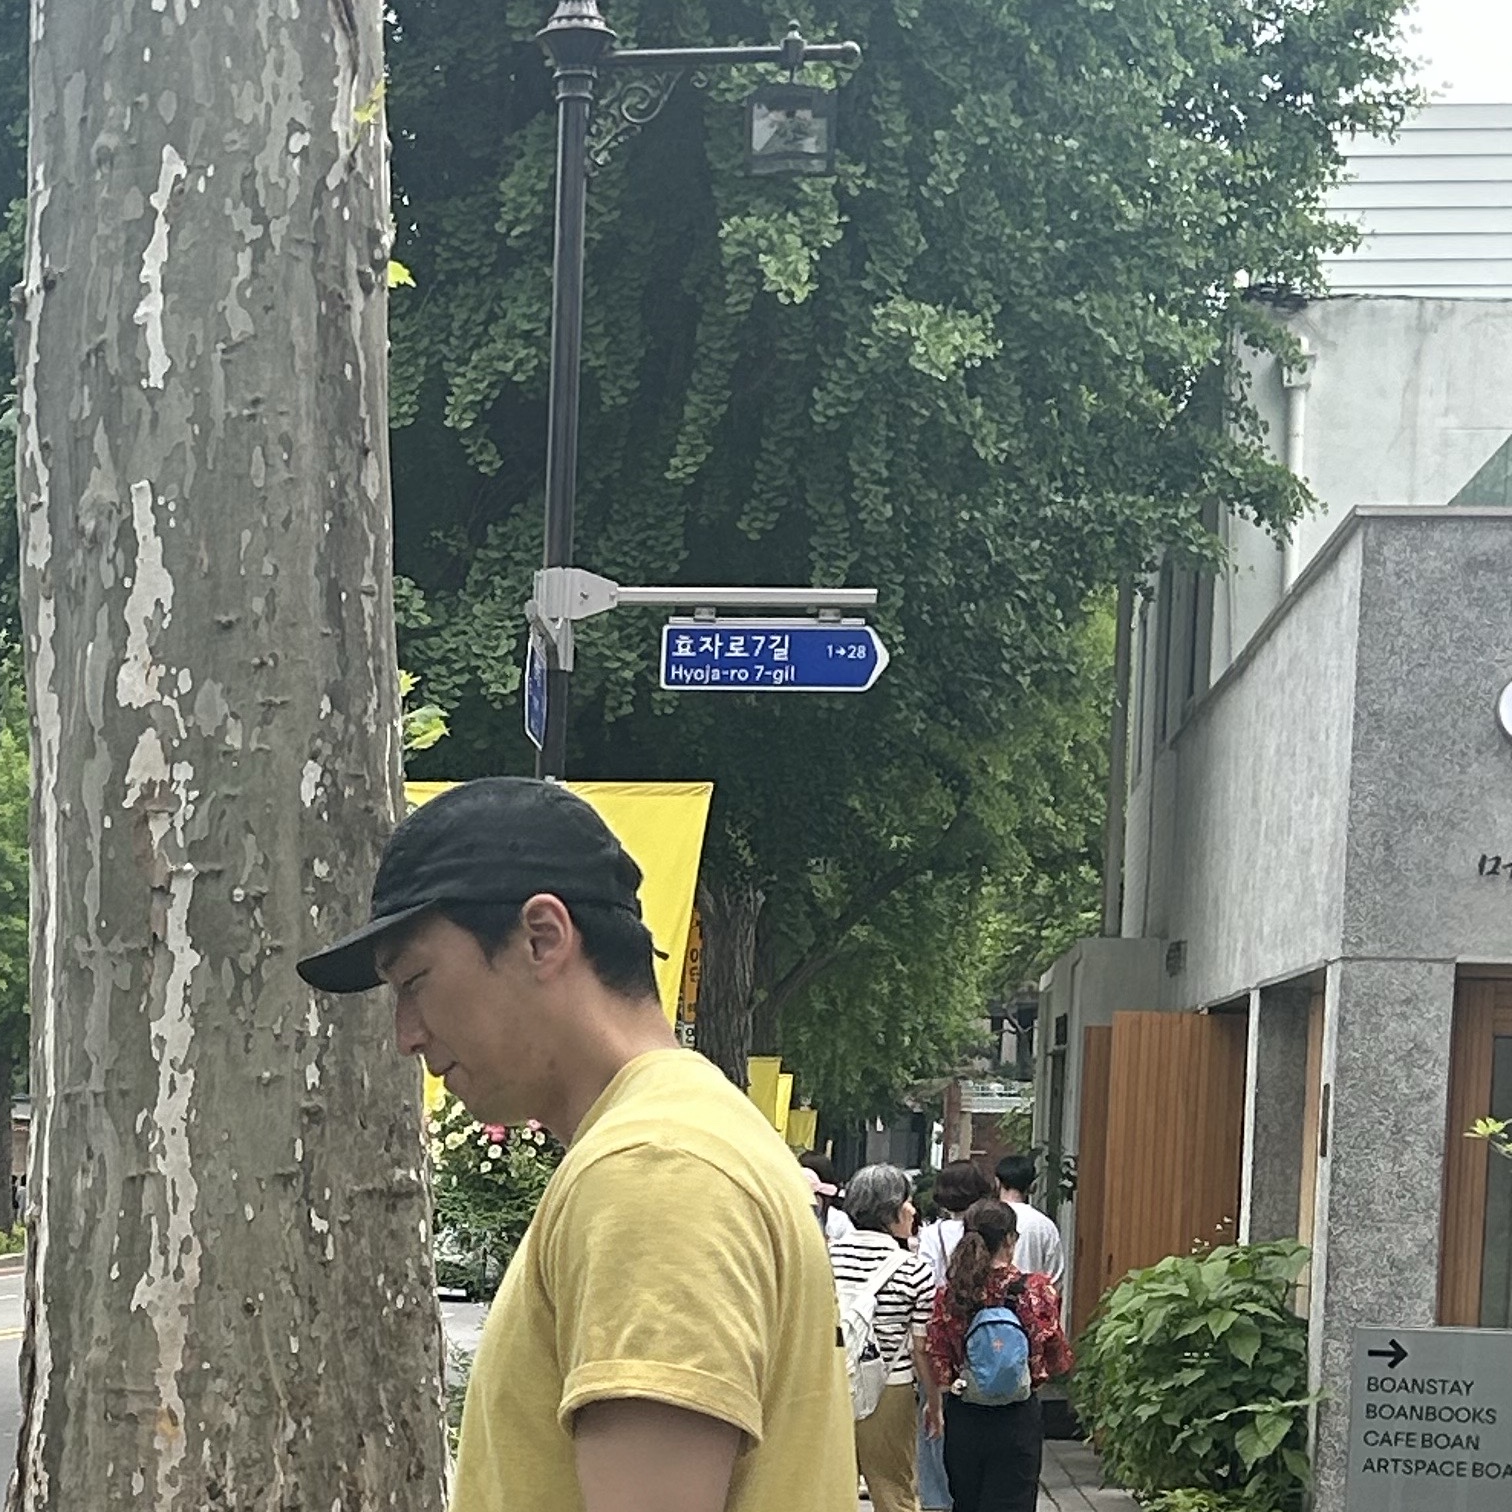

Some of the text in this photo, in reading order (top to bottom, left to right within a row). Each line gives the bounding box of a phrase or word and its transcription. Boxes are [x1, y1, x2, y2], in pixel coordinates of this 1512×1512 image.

[671, 633, 789, 661] 효자로7길
[671, 664, 795, 684] Hyoja-ro 7-gil
[1367, 1376, 1474, 1396] BOANSTAY
[1365, 1403, 1497, 1425] BOANBOOKS
[1363, 1430, 1480, 1450] CAFE BOAN
[1362, 1457, 1467, 1477] ARTSPACE
